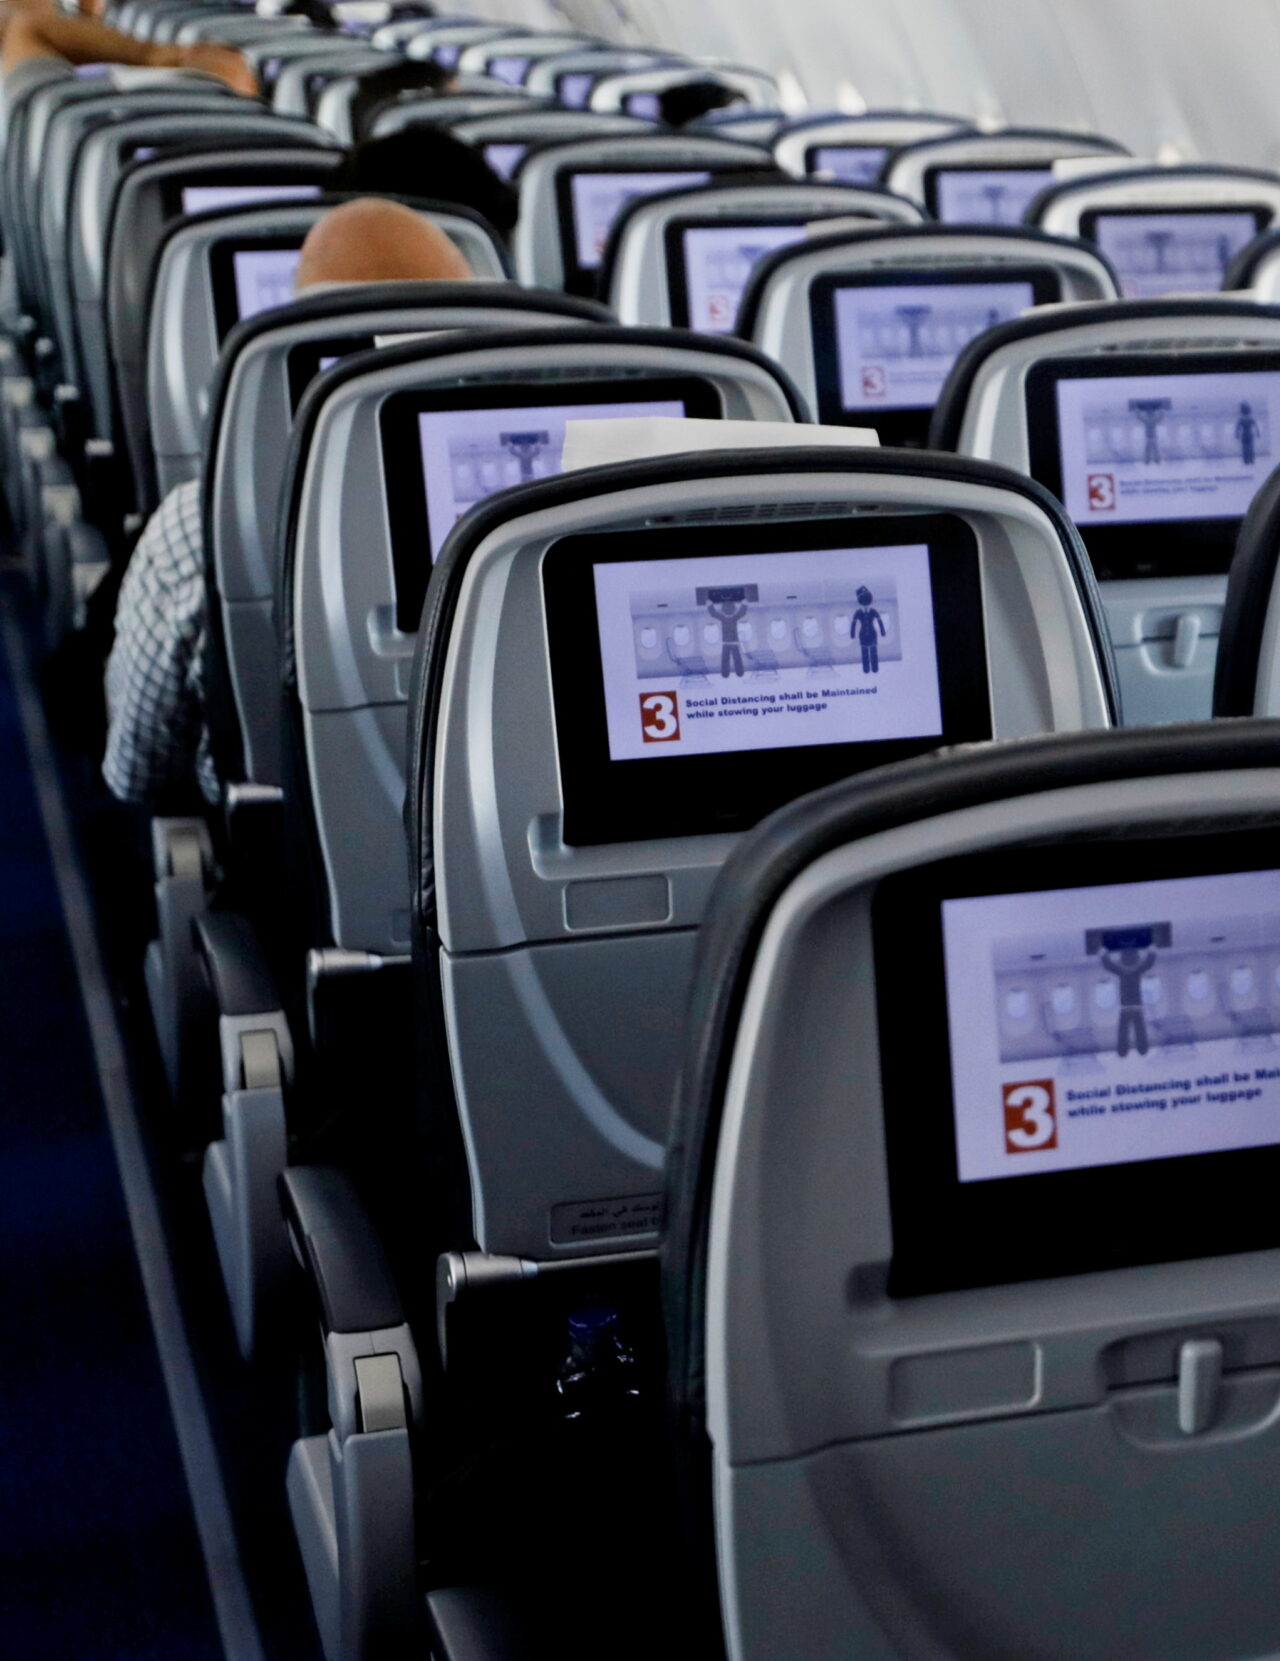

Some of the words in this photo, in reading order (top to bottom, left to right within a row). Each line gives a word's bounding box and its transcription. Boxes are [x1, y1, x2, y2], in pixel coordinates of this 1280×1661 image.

[1090, 475, 1114, 509] 3
[685, 698, 718, 708] Social
[720, 693, 776, 706] Distancing
[779, 690, 803, 701] shall
[806, 689, 819, 699] be
[821, 686, 878, 698] Maintained
[686, 709, 715, 720] while
[717, 706, 759, 718] stowing
[761, 704, 784, 715] your
[786, 702, 828, 713] luggage
[642, 695, 678, 739] 3
[1066, 1088, 1111, 1103] Social
[1115, 1079, 1192, 1098] Distancing
[1196, 1073, 1229, 1088] shall
[1232, 1070, 1250, 1083] be
[1067, 1104, 1107, 1119] while
[1110, 1096, 1168, 1115] stowing
[1171, 1094, 1202, 1110] your
[1205, 1086, 1263, 1105] luggage
[1006, 1084, 1057, 1148] 3
[571, 1221, 617, 1236] Fasten
[621, 1216, 649, 1229] seat
